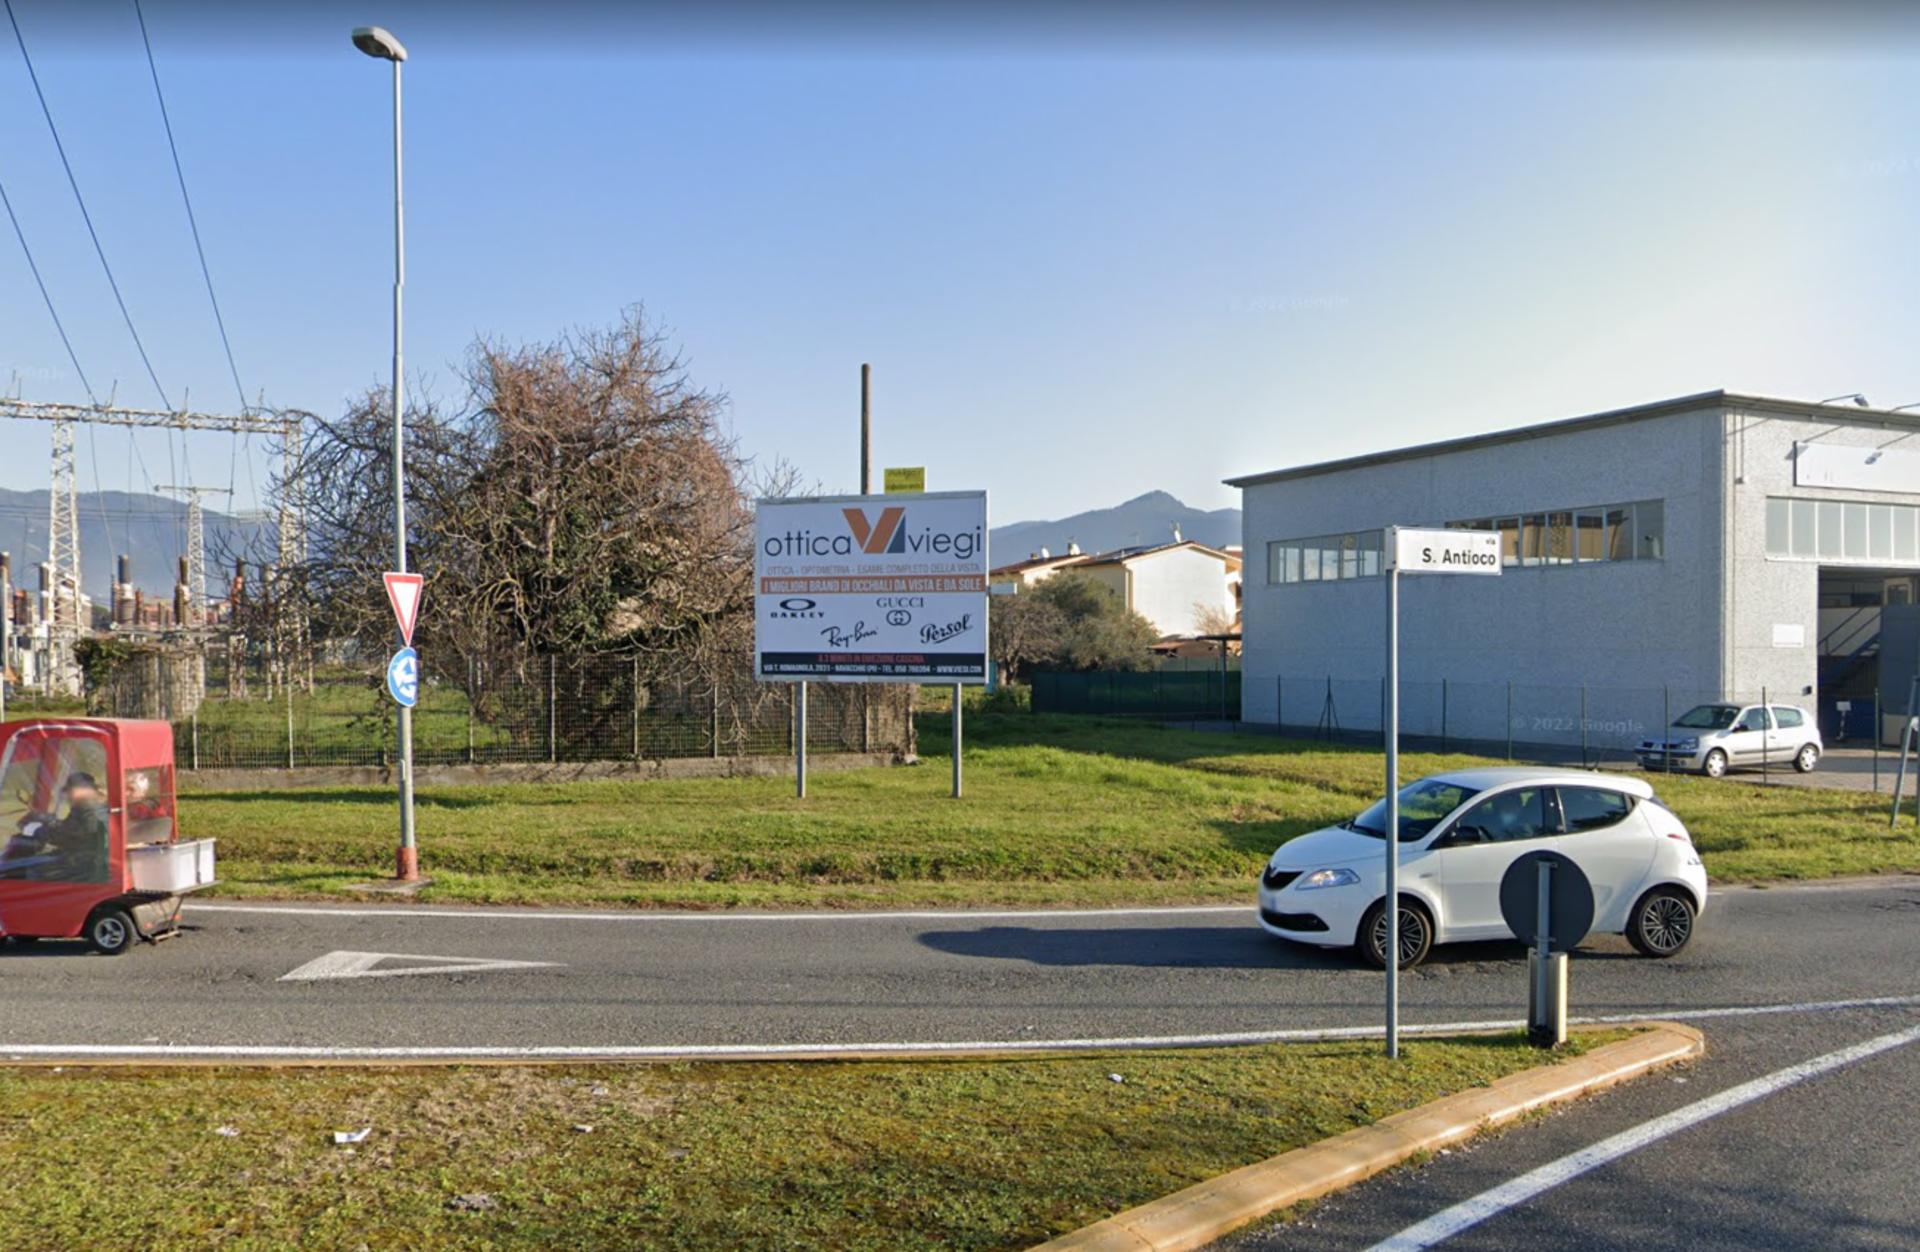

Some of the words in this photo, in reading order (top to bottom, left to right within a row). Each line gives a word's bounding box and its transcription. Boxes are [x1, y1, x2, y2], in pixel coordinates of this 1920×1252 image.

[764, 530, 851, 557] ottica
[907, 526, 982, 560] viegi
[1421, 547, 1437, 563] S.
[1442, 549, 1496, 566] Antioco
[767, 566, 794, 576] OTTICA
[800, 565, 849, 575] OPTOMETRIA
[857, 564, 886, 574] ESAME
[886, 563, 929, 574] COMPLETO
[931, 563, 956, 573] DELLA
[957, 562, 980, 572] VISTA
[769, 580, 808, 593] MIGLIORI
[809, 580, 840, 592] BRAND
[841, 579, 850, 592] DI
[851, 579, 893, 592] OCCHIALI
[894, 579, 906, 592] DA
[908, 578, 935, 591] VISTA
[936, 578, 942, 591] E
[944, 578, 957, 591] DA
[958, 577, 982, 591] SOLE
[876, 597, 925, 609] GUCCI
[770, 611, 825, 619] OAKLEY
[820, 620, 878, 648] Ray-Ban
[919, 612, 974, 644] Persol
